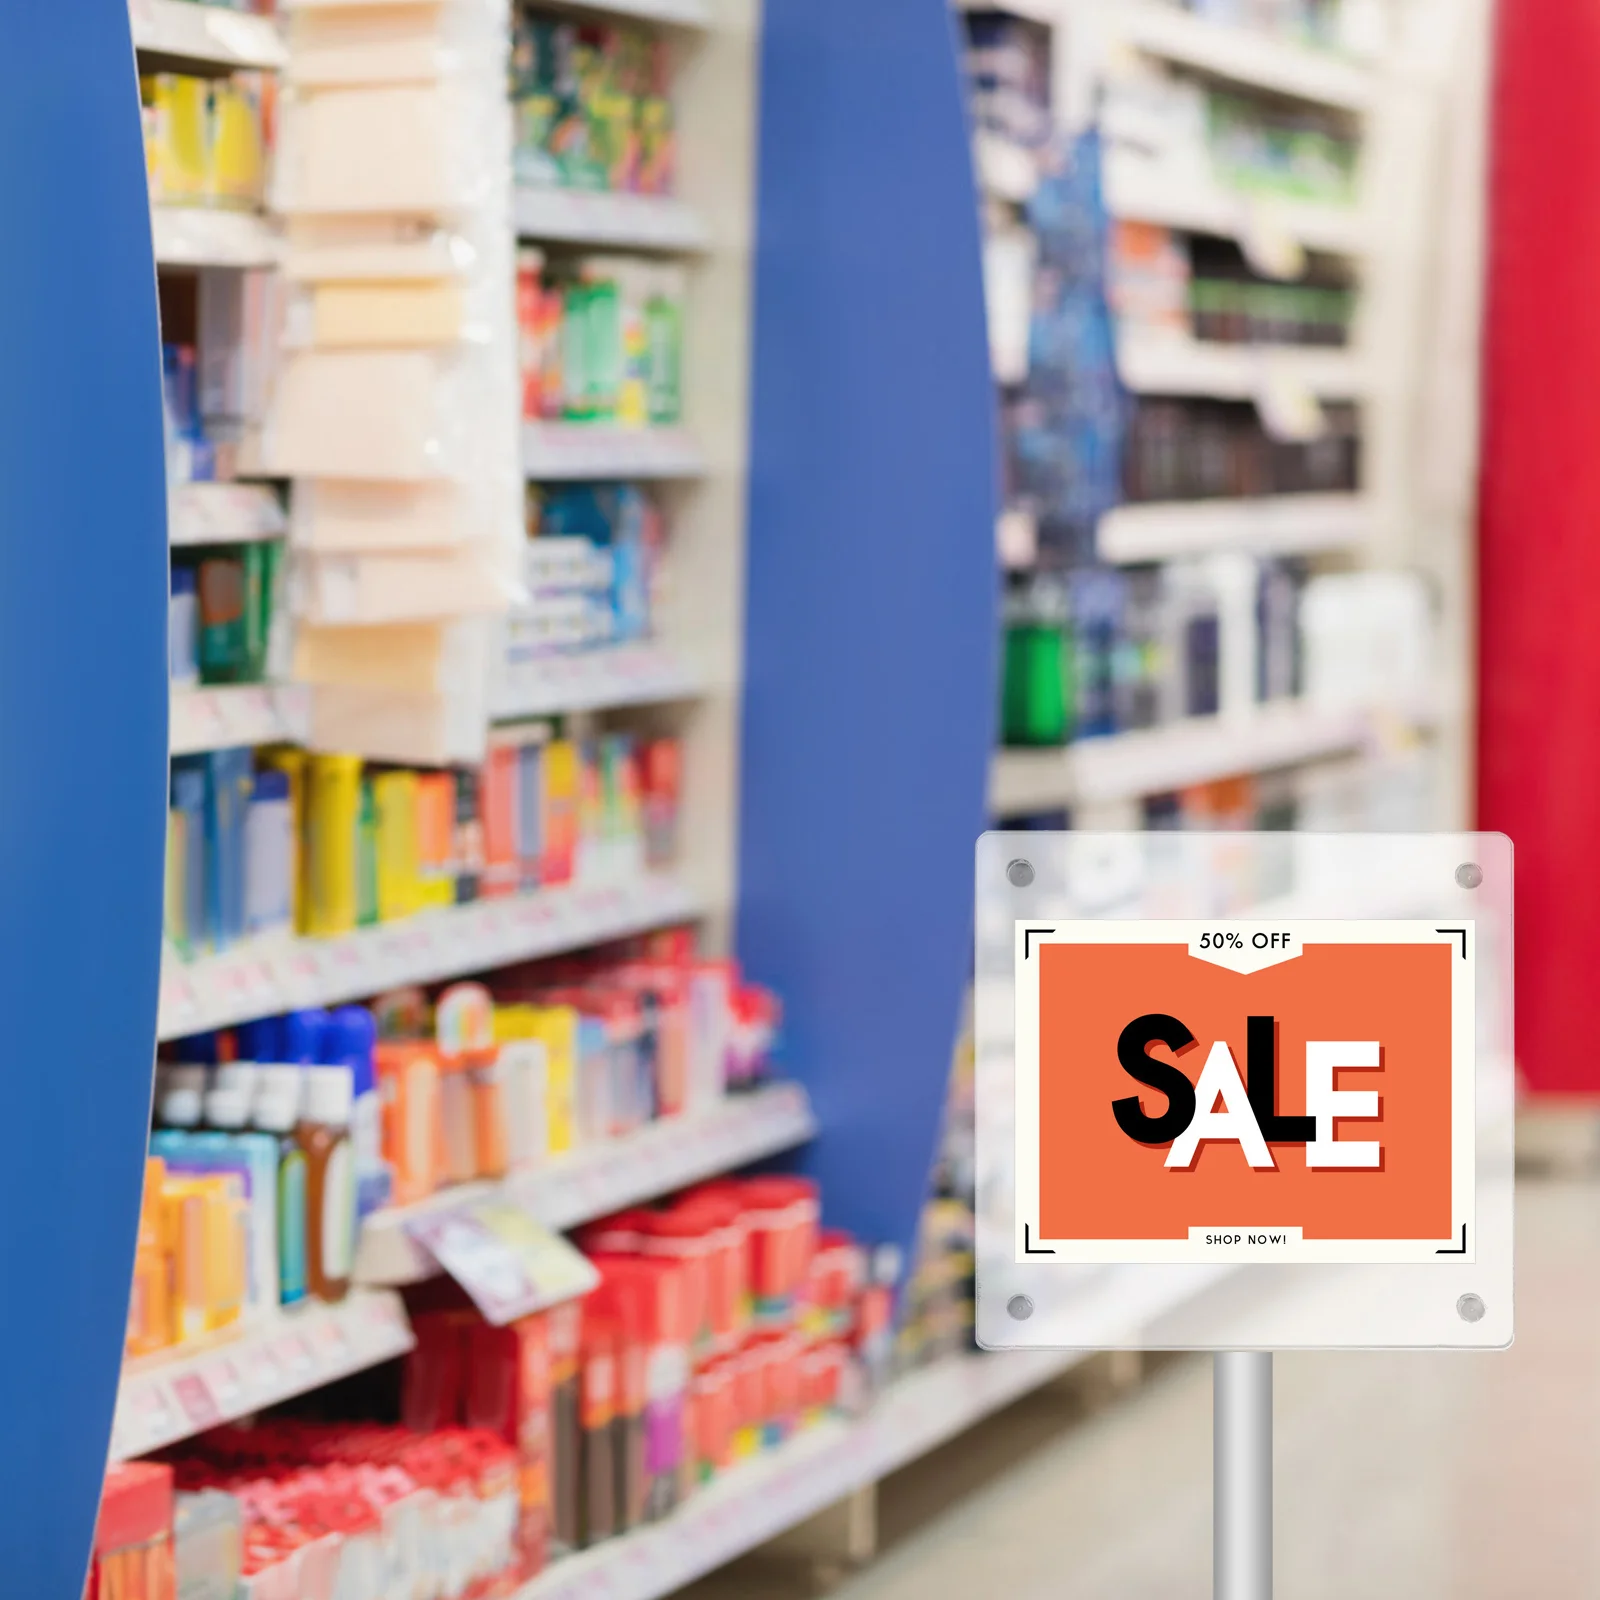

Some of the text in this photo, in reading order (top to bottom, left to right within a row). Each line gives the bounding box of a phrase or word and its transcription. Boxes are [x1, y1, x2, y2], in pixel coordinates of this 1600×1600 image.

[1199, 932, 1291, 949] 50% OFF
[1111, 1013, 1380, 1167] SALE
[1205, 1234, 1286, 1245] SHOP NOW!
